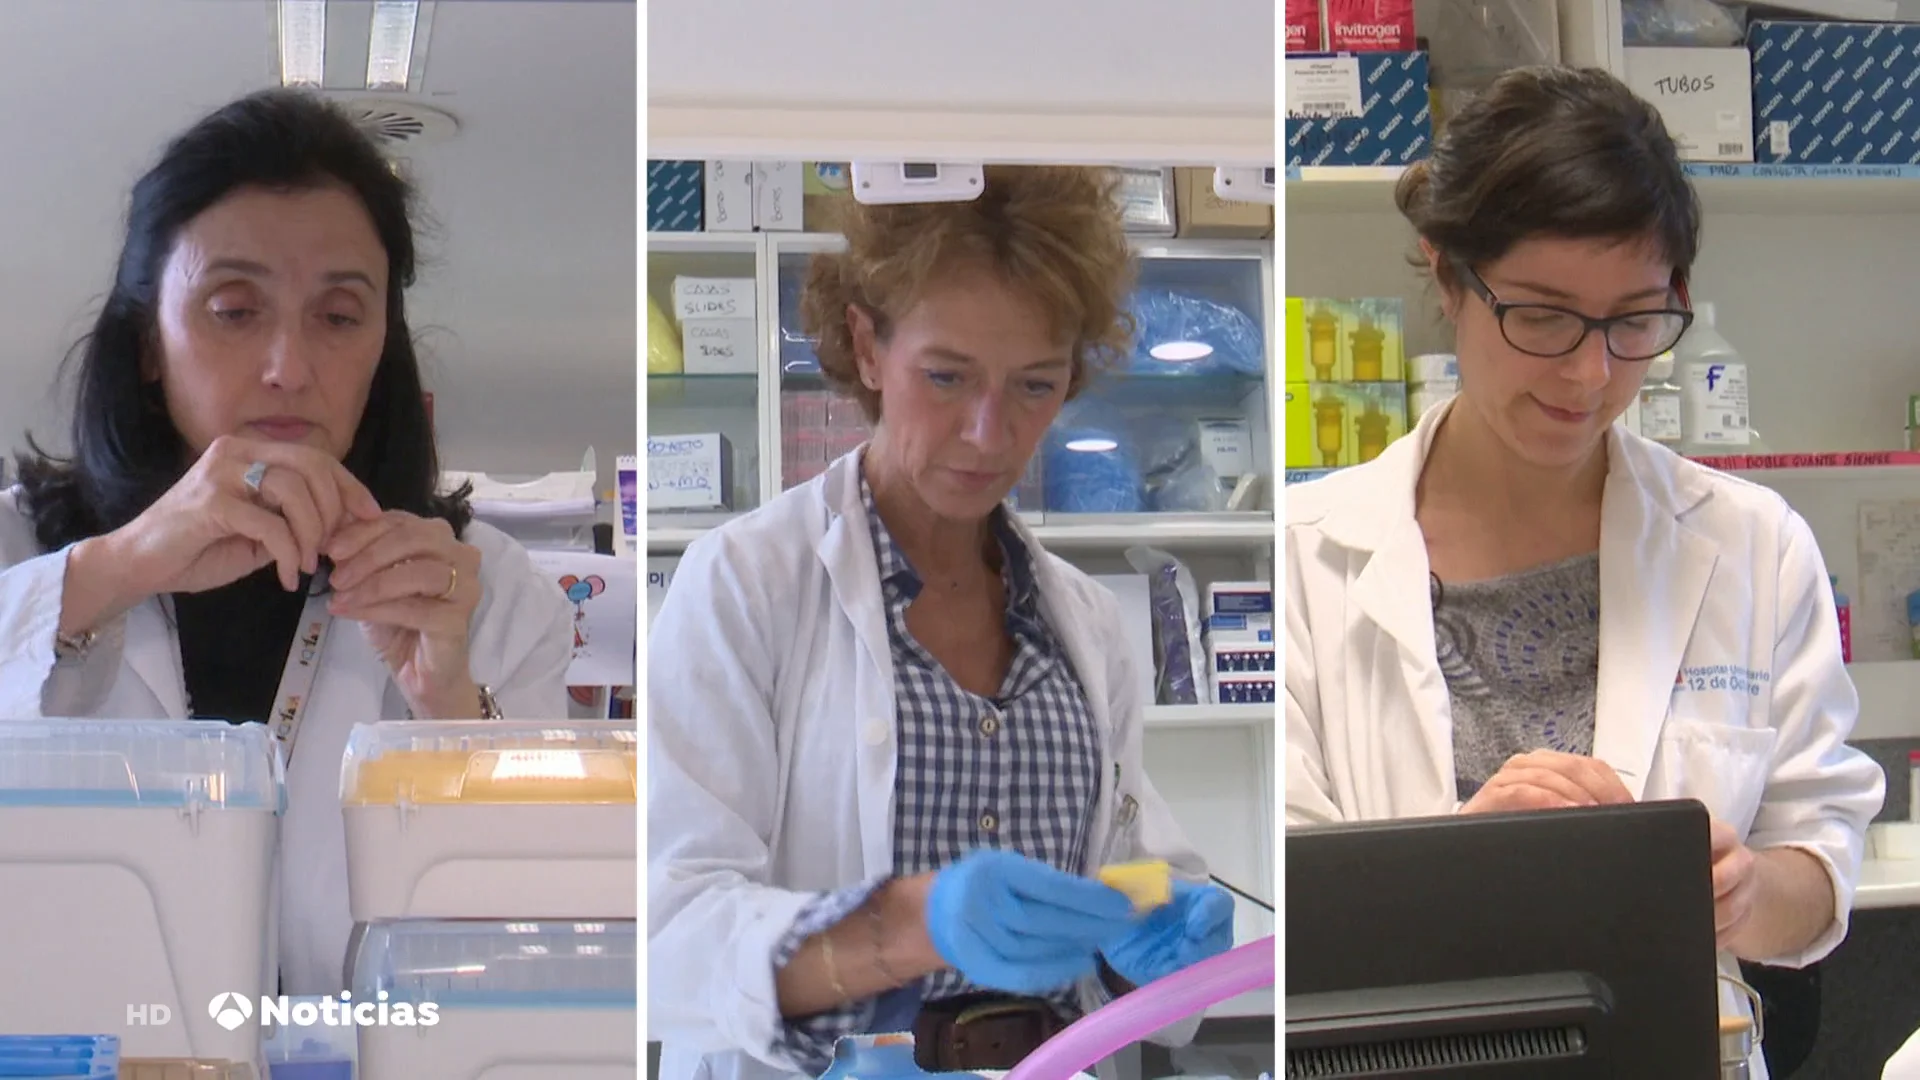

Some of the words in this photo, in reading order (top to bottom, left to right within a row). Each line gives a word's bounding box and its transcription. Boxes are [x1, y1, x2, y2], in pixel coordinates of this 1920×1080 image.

[1335, 20, 1400, 38] invitrogen
[1782, 26, 1804, 52] QIAGEN
[1802, 47, 1825, 72] QIAGEN
[1882, 43, 1905, 69] QIAGEN
[1654, 74, 1715, 95] TUBOS
[1821, 67, 1845, 93] QIAGEN
[1760, 92, 1783, 118] QIAGEN
[1842, 88, 1864, 114] QIAGEN
[1378, 112, 1403, 140] QIAGEN
[1861, 109, 1884, 135] QIAGEN
[1400, 134, 1425, 161] QIAGEN
[1800, 133, 1823, 160] QIAGEN
[1880, 129, 1903, 156] QIAGEN
[1709, 165, 1740, 176] PARA
[1706, 365, 1726, 392] F
[1746, 454, 1788, 469] DOBLE
[1792, 453, 1837, 468] GUANTE
[1843, 452, 1891, 467] SIEMPRE
[1684, 665, 1728, 677] Hospital
[1688, 677, 1706, 692] 12
[1710, 676, 1727, 689] de
